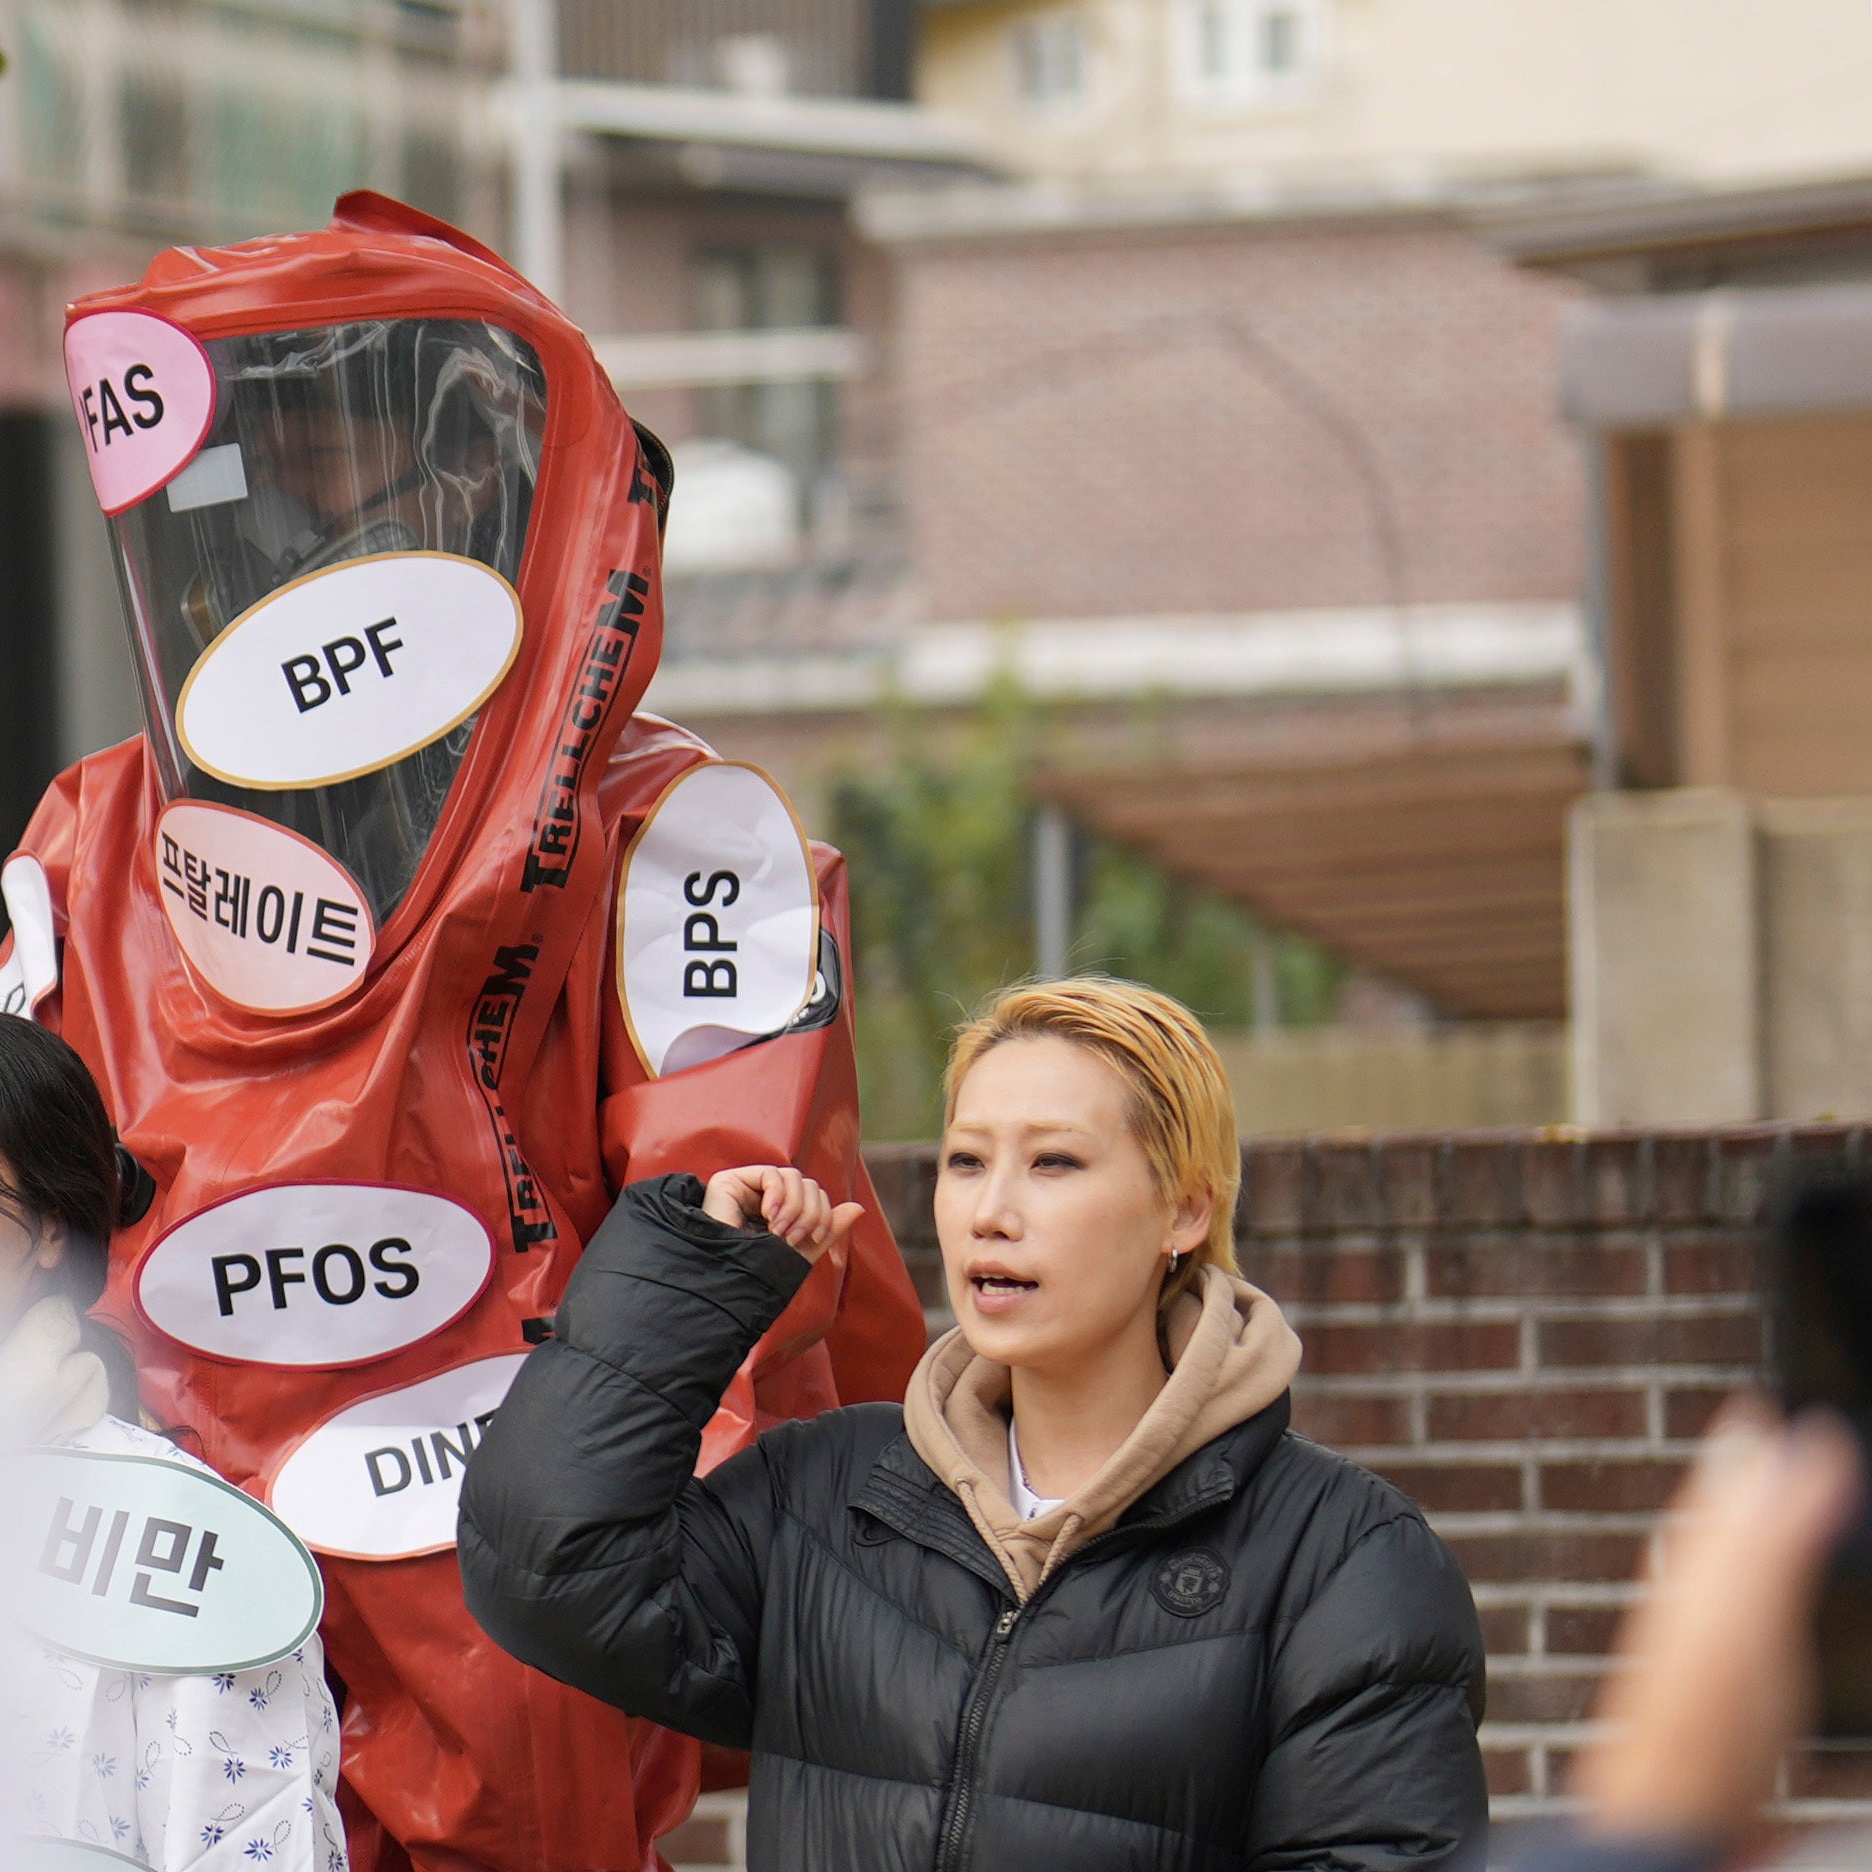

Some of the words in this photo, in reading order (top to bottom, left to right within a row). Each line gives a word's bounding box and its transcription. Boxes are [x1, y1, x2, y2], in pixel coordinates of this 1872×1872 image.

[79, 363, 164, 453] FAS
[281, 616, 404, 714] BPF
[520, 568, 651, 893] TRELLCHEM
[161, 831, 358, 966] 프탈레이트
[683, 868, 740, 998] BPS
[211, 1237, 419, 1317] PFOS
[364, 1411, 494, 1498] DIN
[37, 1496, 224, 1618] 비만
